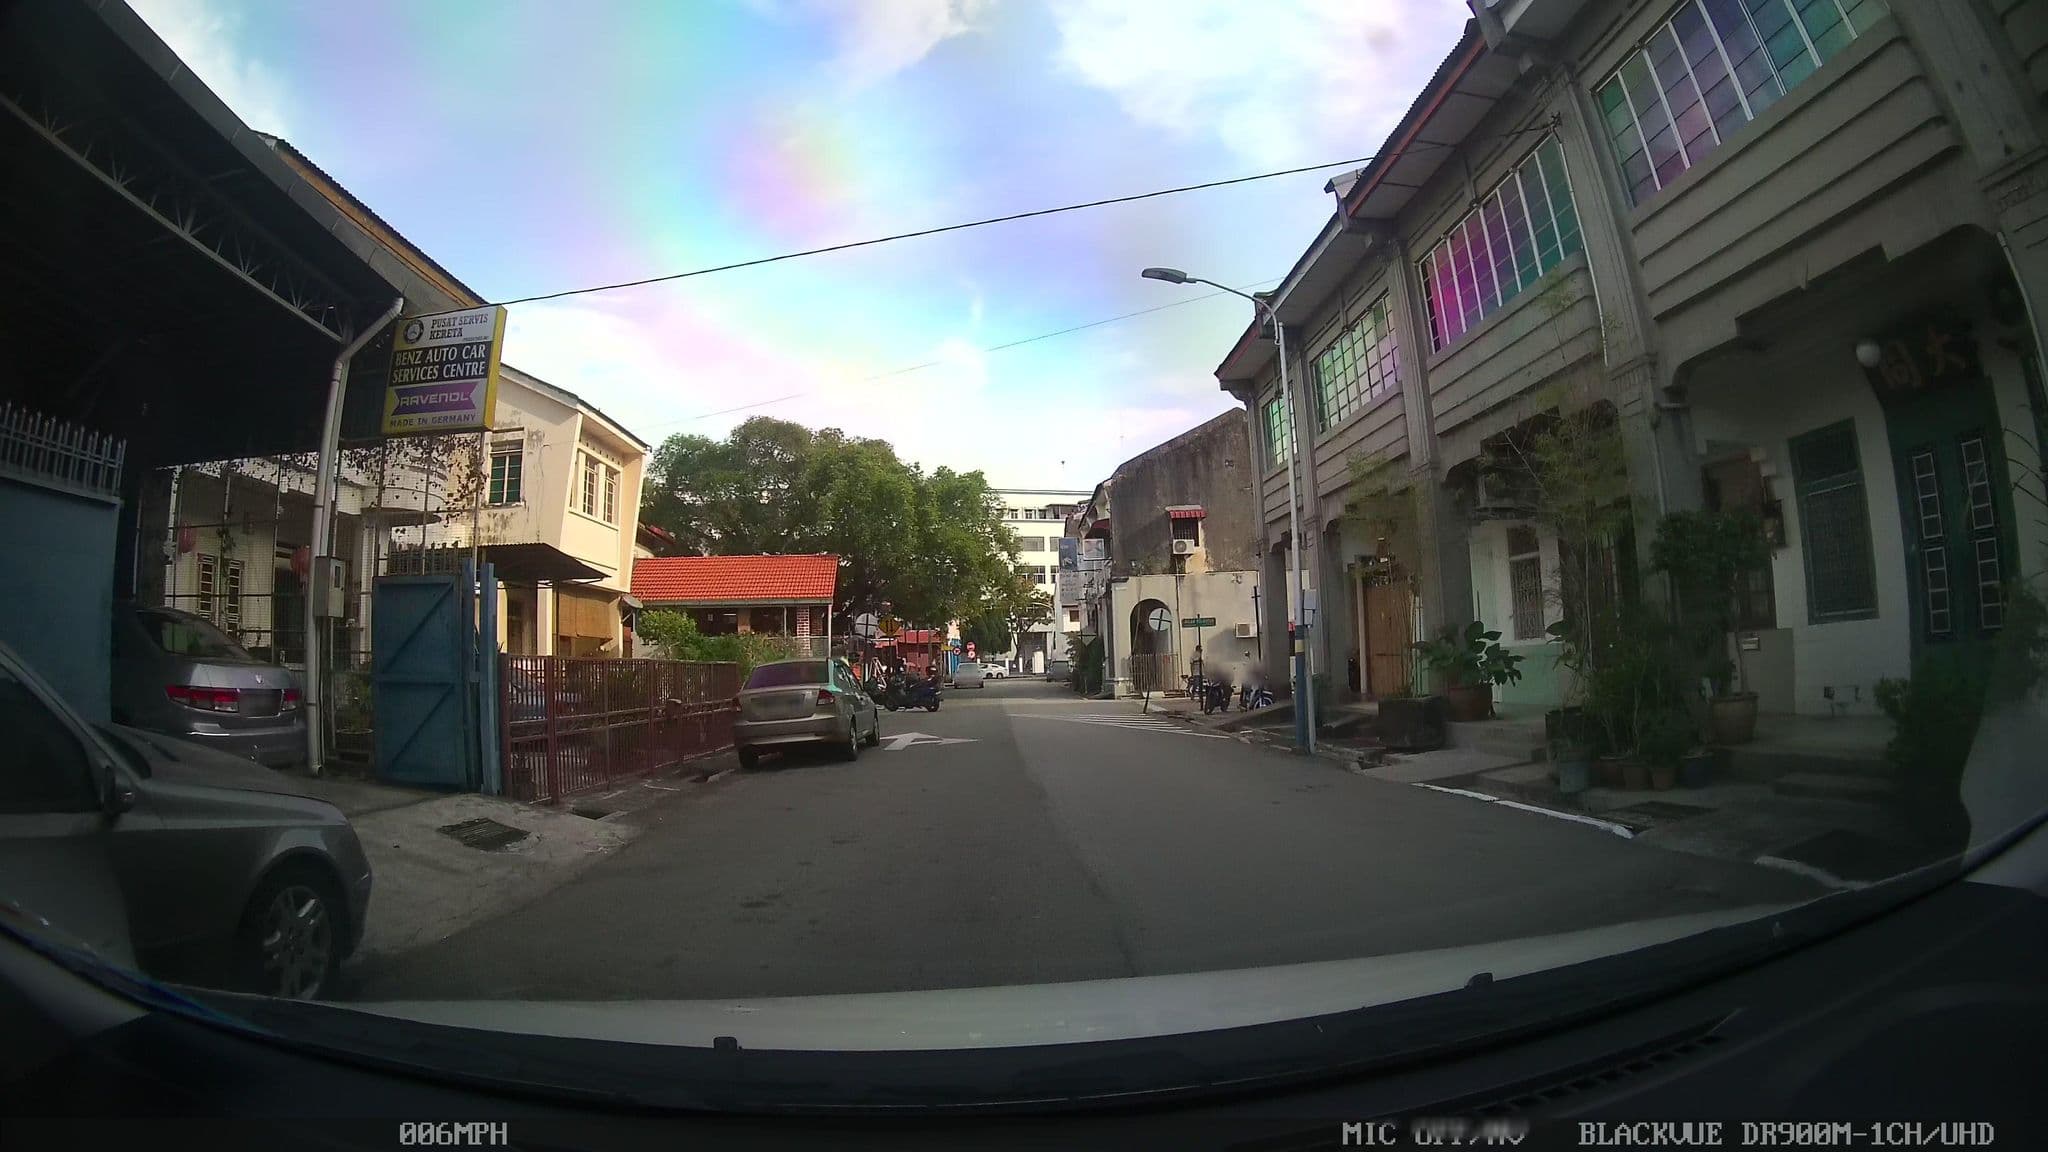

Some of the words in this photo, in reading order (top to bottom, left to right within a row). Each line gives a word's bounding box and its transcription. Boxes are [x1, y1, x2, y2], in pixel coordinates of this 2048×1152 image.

[431, 316, 456, 329] PUSAT
[458, 313, 489, 325] SERVIS
[429, 327, 463, 340] KERETA
[395, 350, 422, 366] BENZ
[425, 346, 458, 363] AUTO
[462, 344, 486, 359] CAR
[392, 365, 439, 383] SERVICES
[442, 361, 486, 378] CENTRE
[400, 391, 469, 407] RAVENOL
[391, 418, 414, 427] MADE
[418, 416, 428, 425] IN
[431, 413, 476, 424] GERMANY
